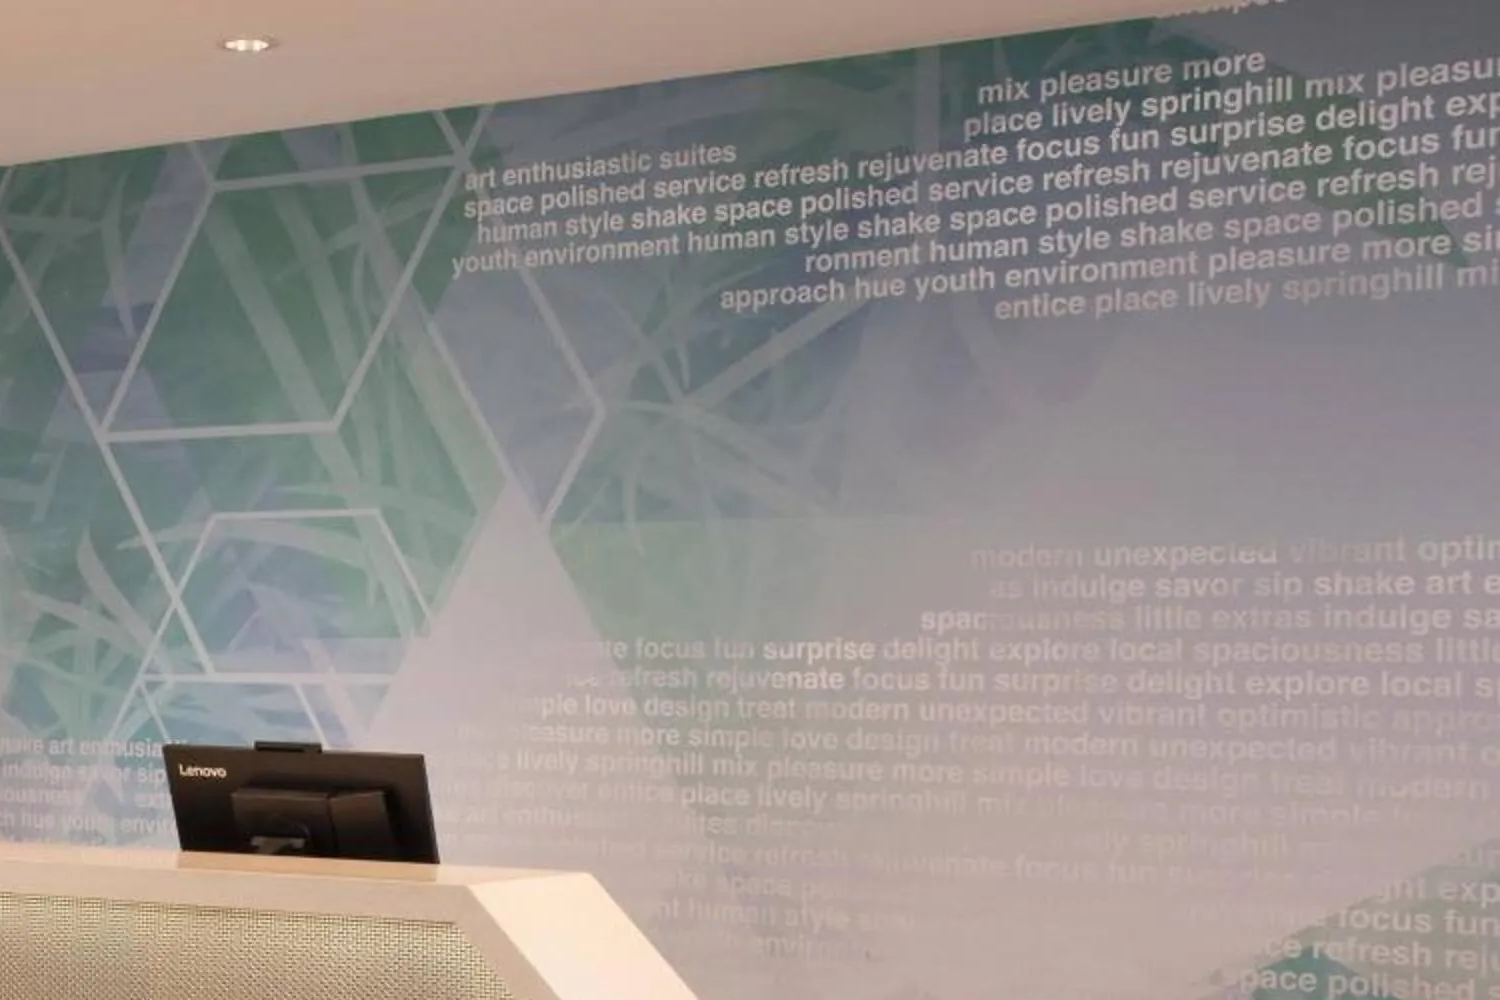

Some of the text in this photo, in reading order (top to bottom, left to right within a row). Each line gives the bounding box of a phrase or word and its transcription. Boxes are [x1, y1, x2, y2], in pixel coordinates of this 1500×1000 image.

[963, 56, 1500, 142] place lively springhill mix pleasu
[978, 53, 1266, 104] mix pleasure more
[464, 195, 533, 222] space
[541, 179, 645, 215] polished
[652, 170, 745, 198] service
[753, 158, 849, 188] refresh
[858, 144, 1009, 182] rejuvenate
[1017, 134, 1101, 162] focus
[1110, 128, 1160, 152] fun
[1171, 112, 1307, 147] surprise
[1316, 94, 1436, 131] delight
[464, 142, 737, 191] art enthusiastic suites
[477, 132, 1441, 244] human style shake space polished service refresh rejuvenate focus
[452, 248, 518, 280] youth
[524, 233, 680, 269] environment
[688, 226, 776, 252] human
[784, 214, 850, 248] style
[858, 211, 942, 239] shake
[950, 205, 1038, 235] space
[1046, 187, 1178, 228] polished
[1188, 178, 1308, 210] service
[1317, 162, 1440, 198] refresh
[805, 191, 1484, 273] ronment human style shake space polished
[720, 234, 1452, 314] approach hue youth environment pleasure more
[995, 263, 1444, 320] entice place lively springhill
[1094, 540, 1278, 572] unexpected
[1155, 577, 1244, 598] savor
[1253, 570, 1303, 603] sip
[1314, 570, 1416, 597] shake
[1426, 570, 1474, 595] art
[1134, 602, 1452, 636] little extras indulge
[635, 636, 707, 660] focus
[763, 636, 876, 665] surprise
[884, 637, 981, 667] delight
[990, 637, 1101, 668] explore
[1110, 637, 1184, 663] local
[1192, 635, 1425, 667] spaciousness
[707, 664, 847, 694] rejuvenate
[853, 666, 931, 691] focus
[939, 666, 985, 692] fun
[993, 668, 1119, 697] surprise
[1127, 668, 1237, 700] delight
[1245, 670, 1371, 701] explore
[1381, 670, 1462, 697] local
[644, 694, 730, 722] design
[737, 697, 797, 720] treat
[920, 698, 1091, 729] unexpected
[179, 764, 227, 778] Lenovo
[517, 748, 580, 775] lively
[712, 753, 757, 777] mix
[681, 783, 828, 815] place lively
